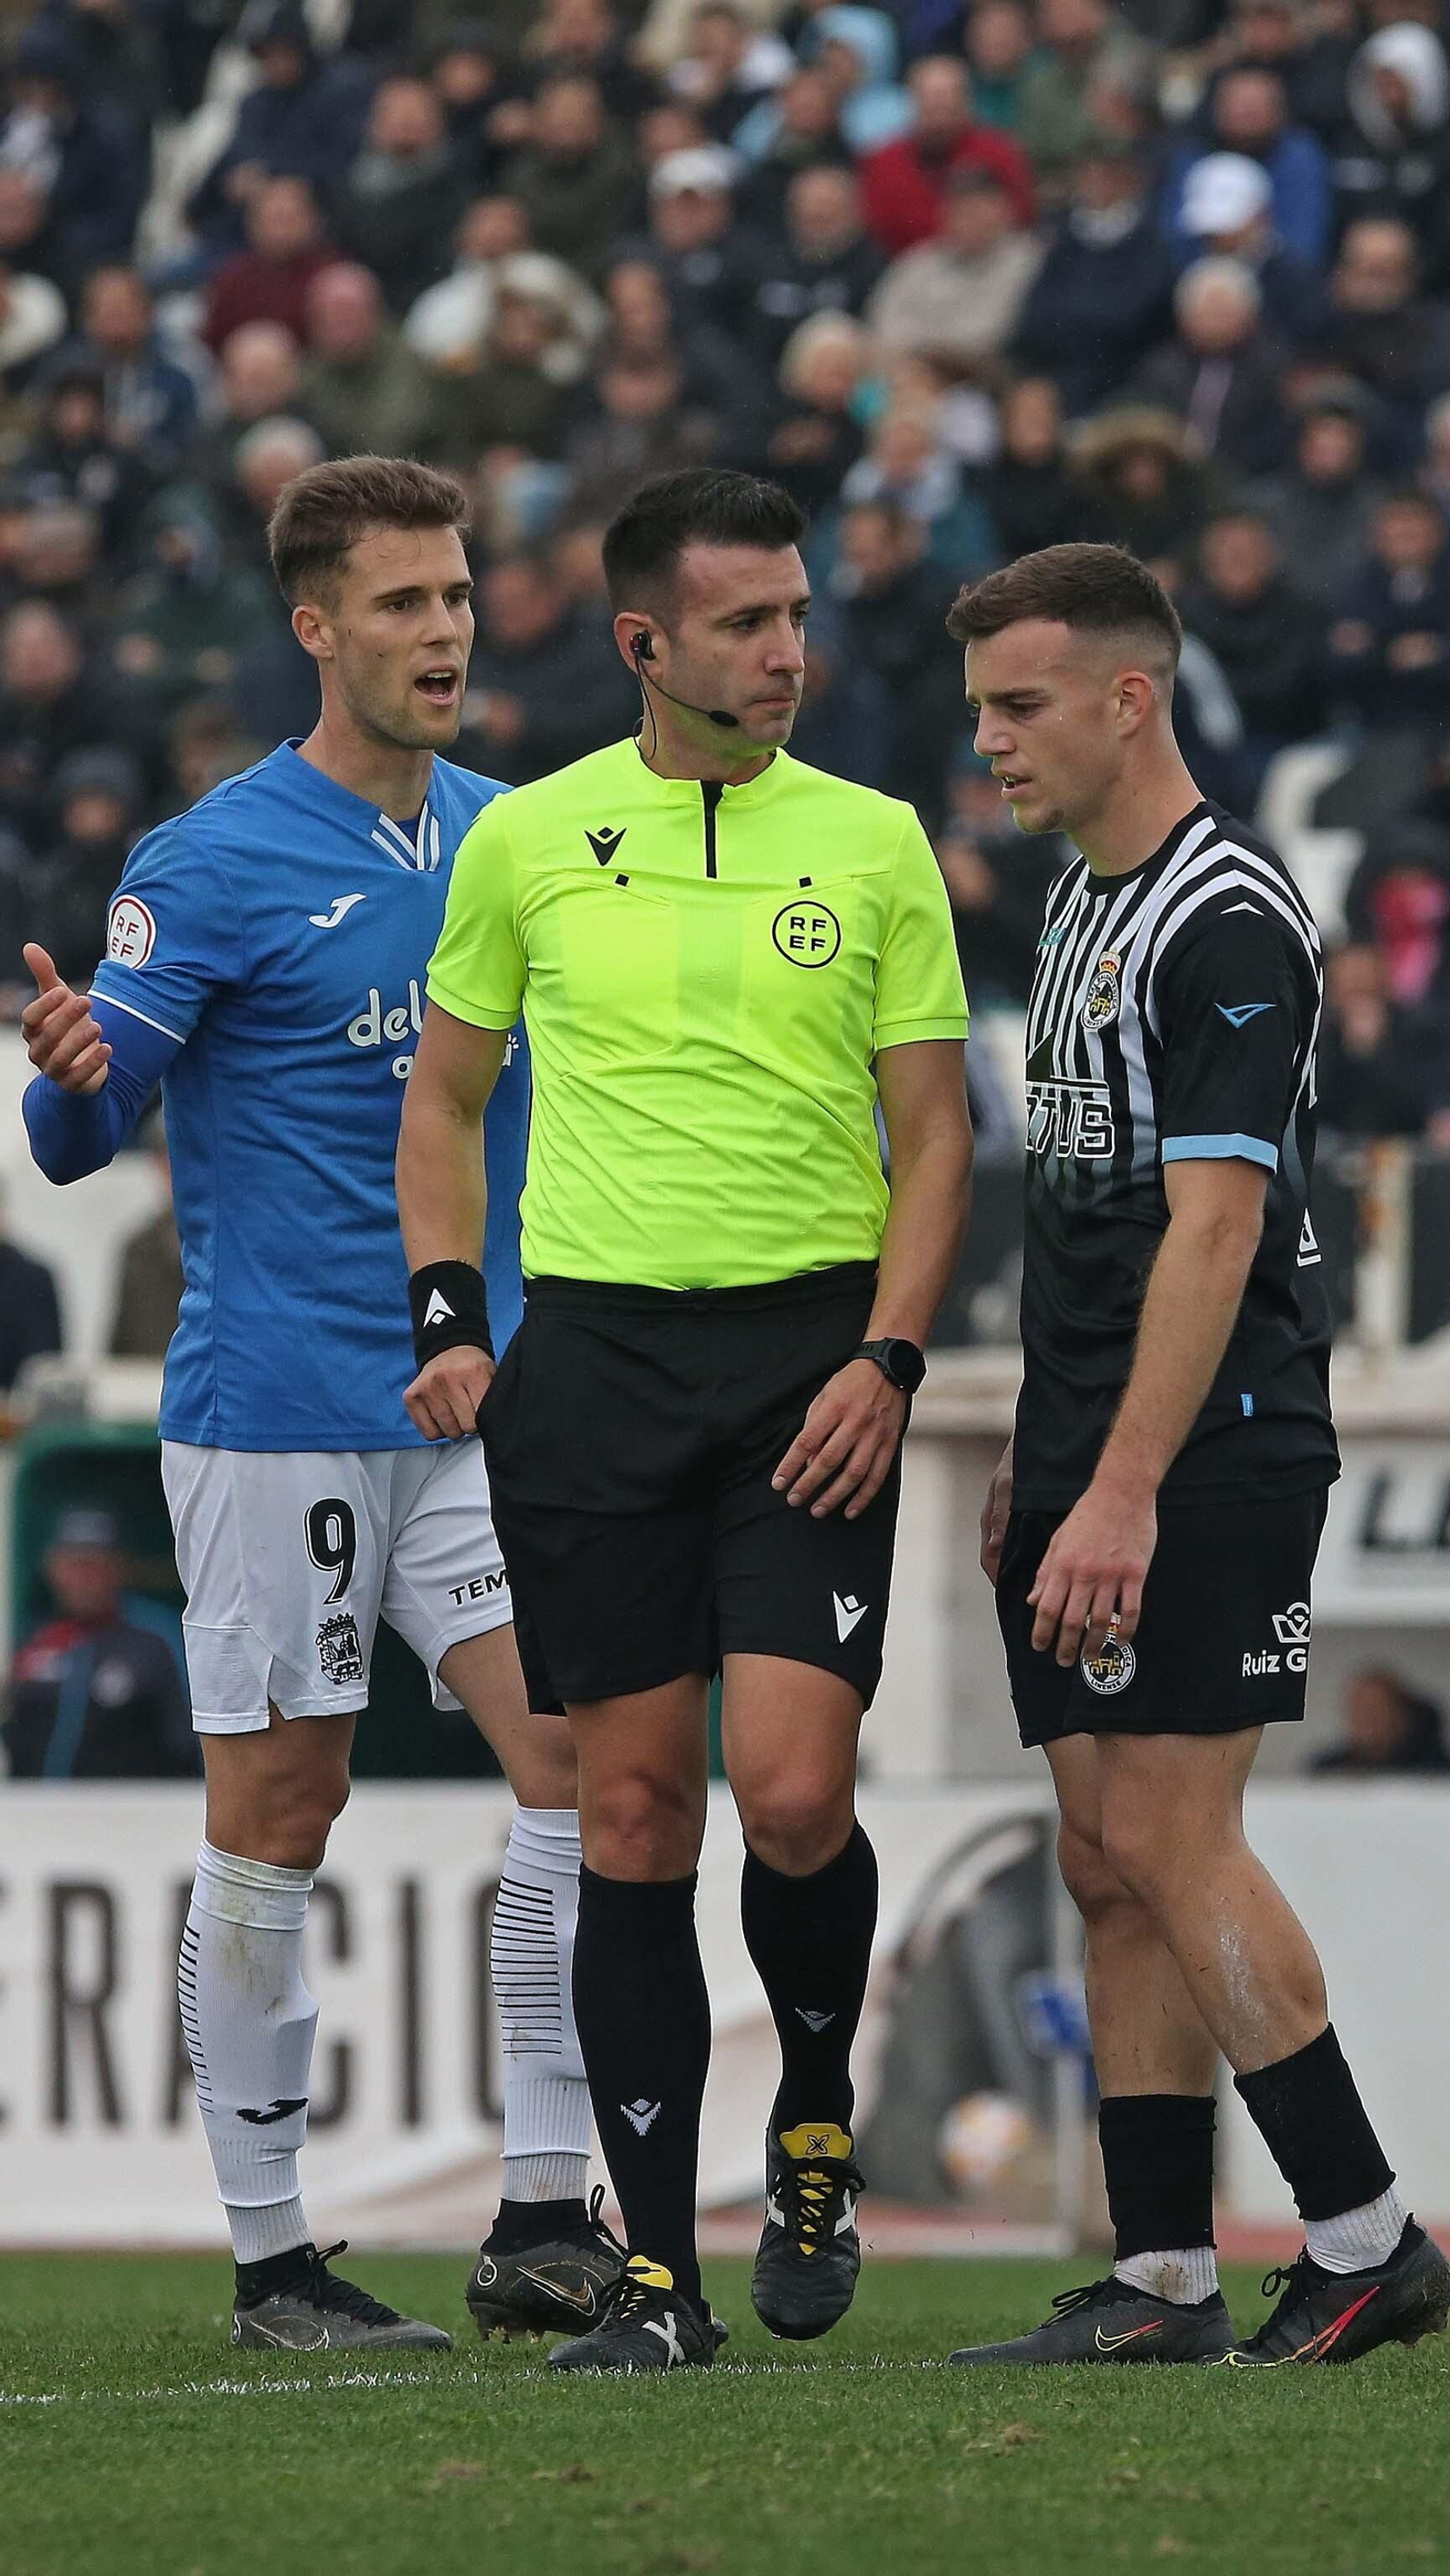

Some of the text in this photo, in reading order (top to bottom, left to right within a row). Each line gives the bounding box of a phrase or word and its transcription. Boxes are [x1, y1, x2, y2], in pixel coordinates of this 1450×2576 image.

[115, 914, 140, 937] RF
[790, 916, 827, 932] RF
[111, 936, 135, 958] EF
[789, 934, 826, 951] EF
[303, 1496, 358, 1606] 9
[1242, 1649, 1281, 1678] Ruiz
[0, 1874, 506, 2126] RCI
